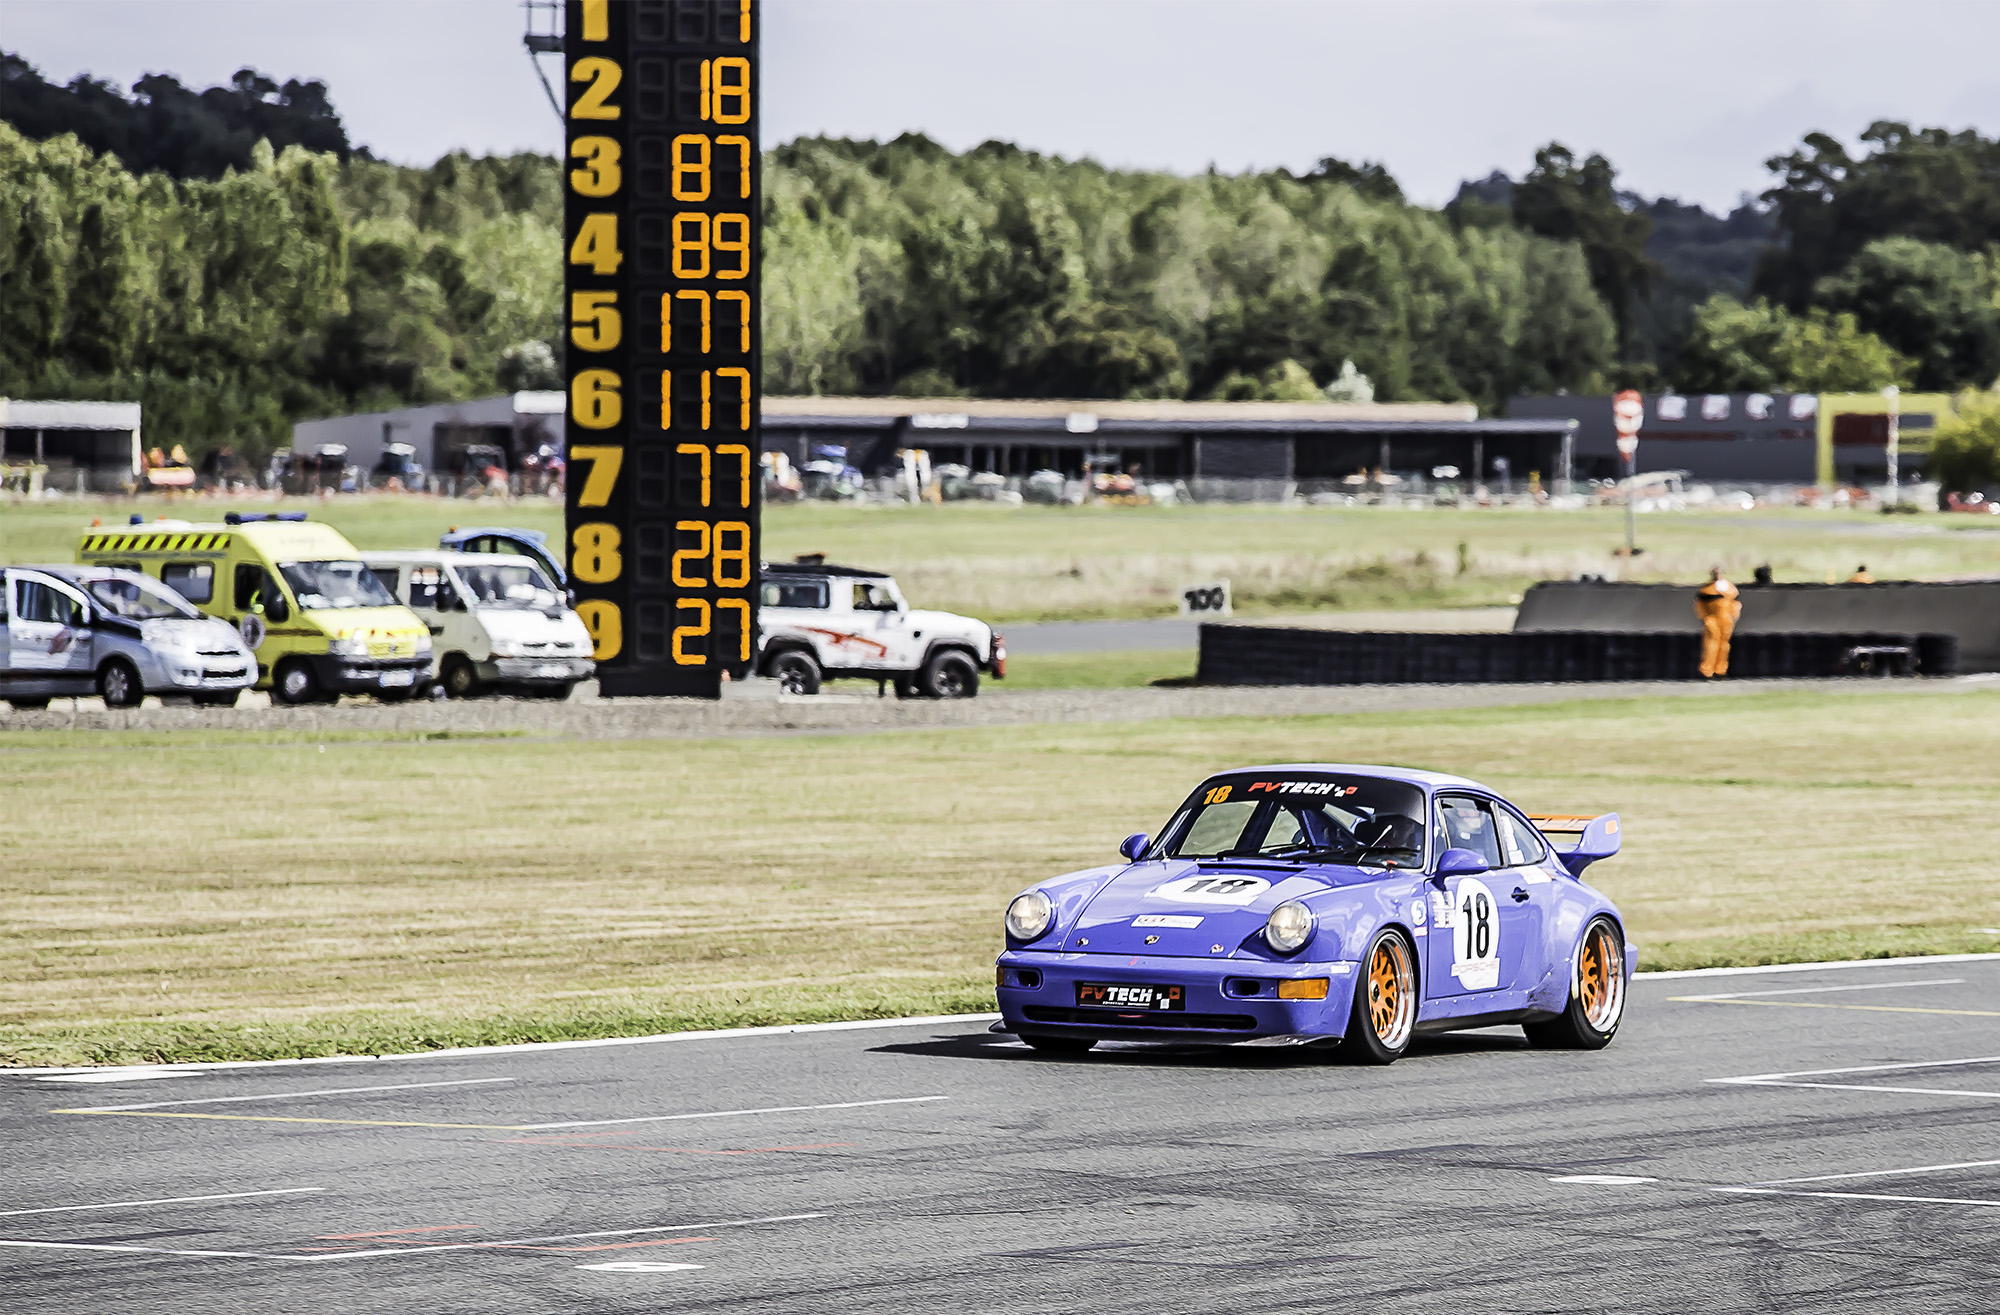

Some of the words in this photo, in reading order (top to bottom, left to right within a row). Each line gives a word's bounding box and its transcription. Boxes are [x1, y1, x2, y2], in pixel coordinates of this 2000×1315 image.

[581, 0, 608, 41] 1
[571, 57, 622, 119] 2
[700, 57, 750, 124] 18
[571, 136, 621, 197] 3
[672, 134, 750, 201] 87
[571, 213, 622, 275] 4
[672, 212, 750, 279] 89
[571, 290, 622, 351] 5
[661, 290, 750, 353] 177
[572, 369, 622, 429] 6
[661, 367, 750, 430] 117
[571, 446, 623, 507] 7
[677, 444, 750, 508] 77
[572, 523, 622, 583] 8
[672, 521, 750, 588] 28
[1185, 586, 1224, 611] 100
[574, 600, 622, 660] 9
[672, 598, 750, 665] 27
[1203, 785, 1233, 805] 18
[1184, 878, 1258, 894] 18
[1462, 892, 1490, 960] 18
